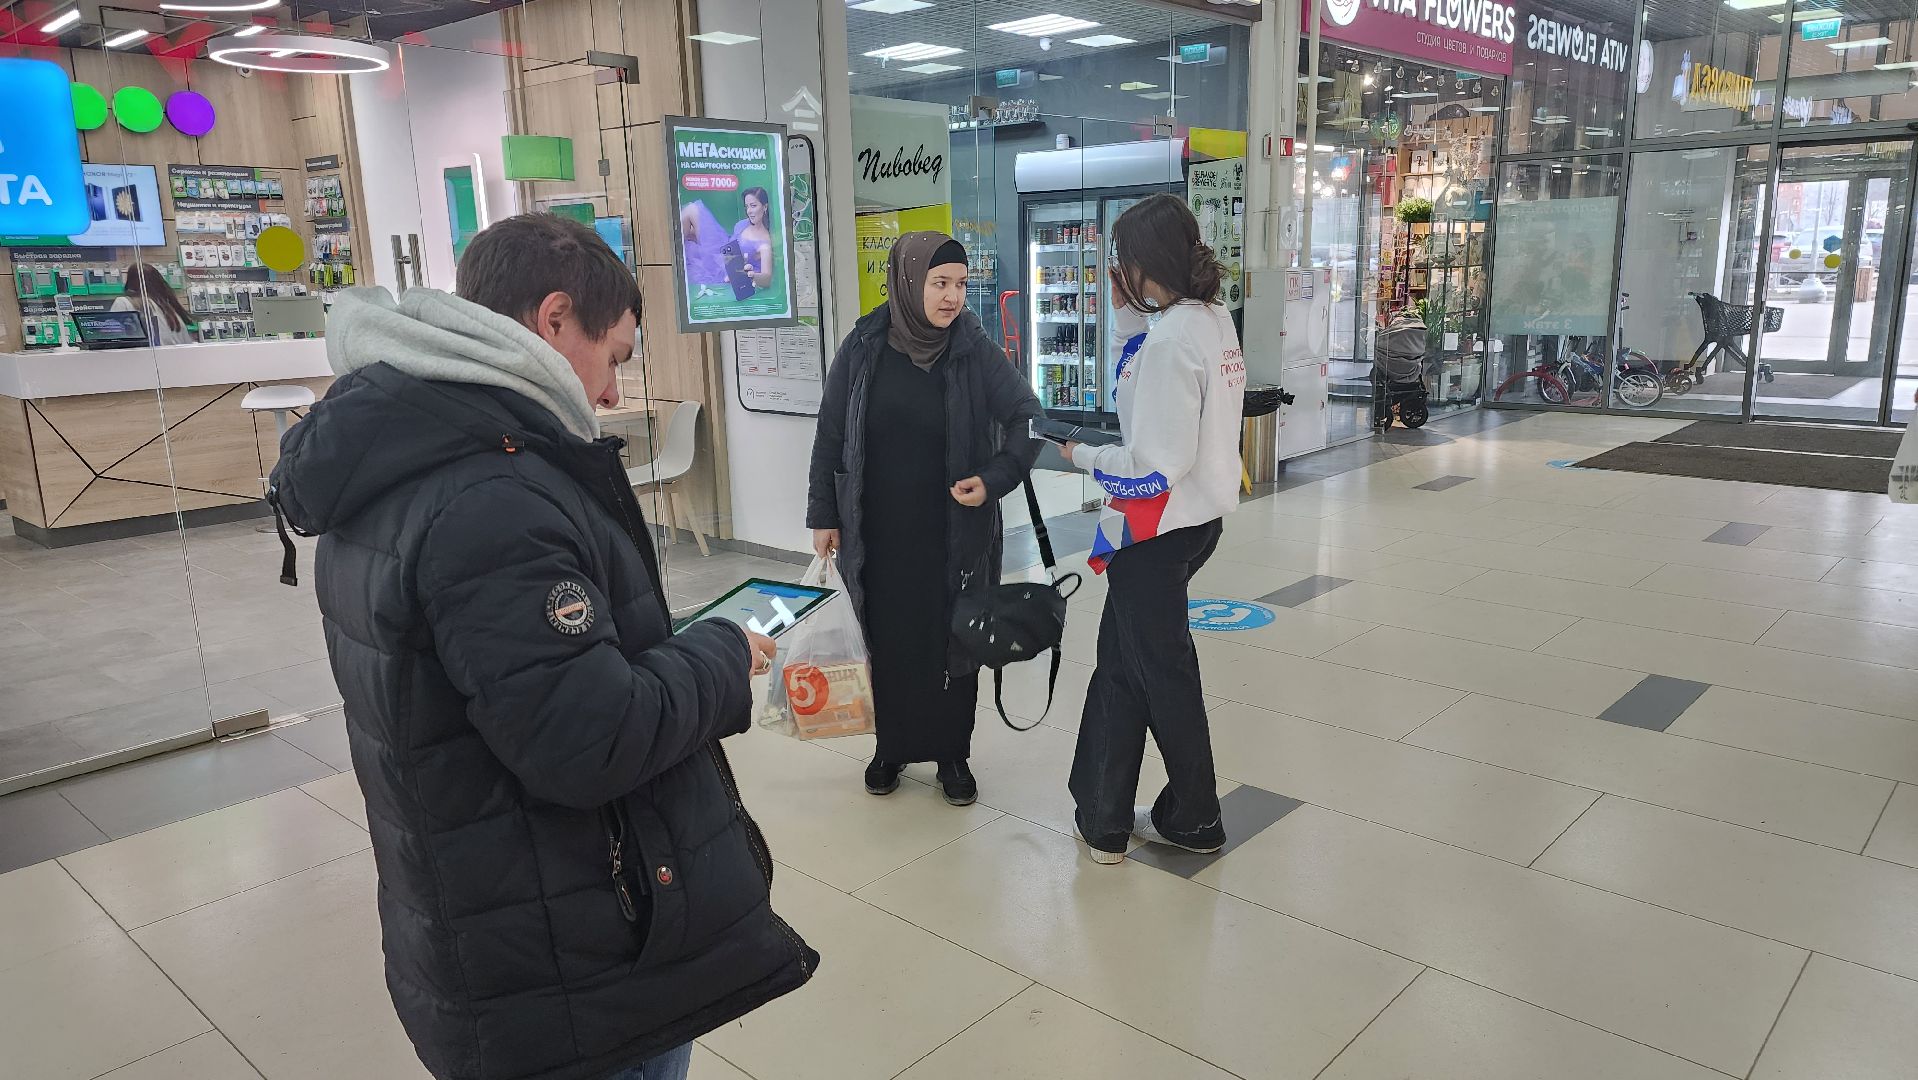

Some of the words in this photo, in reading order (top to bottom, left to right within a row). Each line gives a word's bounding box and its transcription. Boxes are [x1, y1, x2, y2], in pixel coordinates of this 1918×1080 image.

[1424, 0, 1515, 44] FLOWERS
[1416, 31, 1441, 48] СТУДИЯ
[1443, 38, 1467, 54] ЦВЕТОВ
[1469, 44, 1474, 55] И
[1476, 45, 1507, 63] ПОДАРКОВ
[678, 141, 766, 161] МЕГАСКИДКИ
[681, 161, 690, 169] НА
[23, 305, 58, 313] Зарядны
[1136, 479, 1162, 496] МЫ
[789, 667, 817, 708] 5
